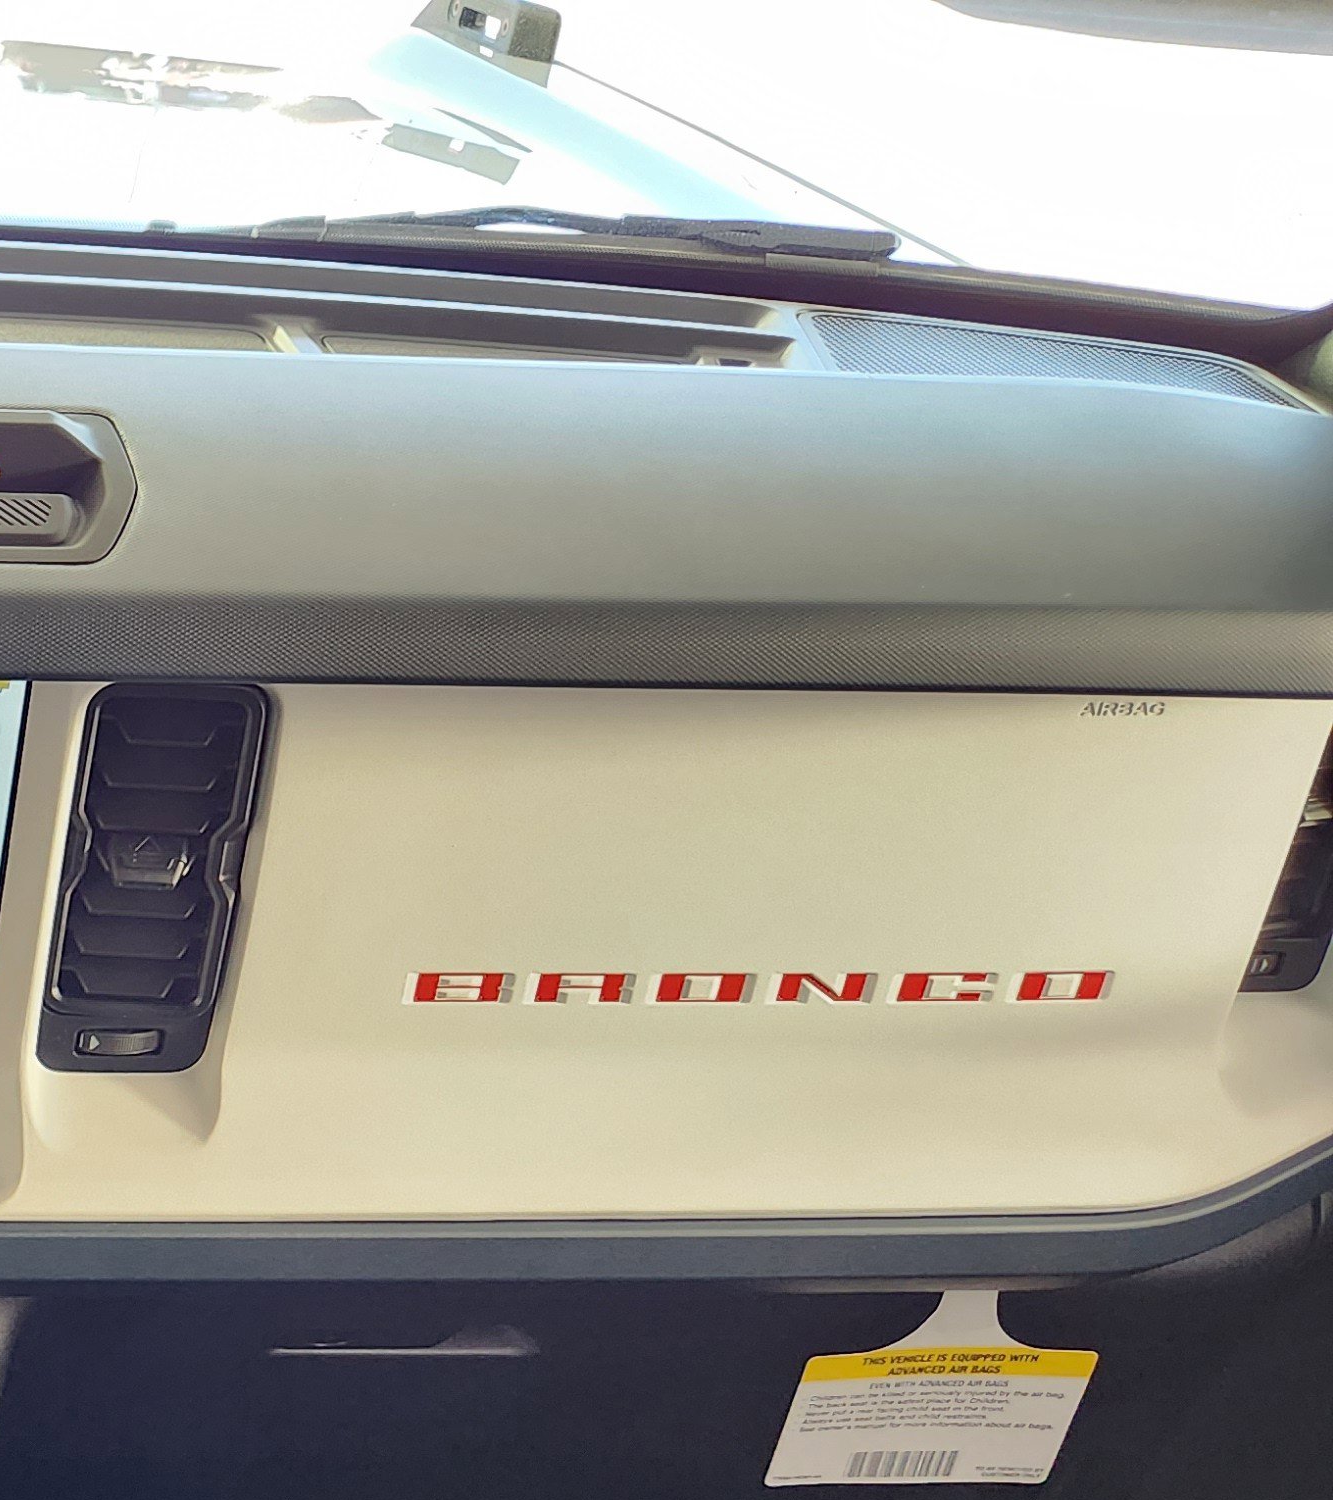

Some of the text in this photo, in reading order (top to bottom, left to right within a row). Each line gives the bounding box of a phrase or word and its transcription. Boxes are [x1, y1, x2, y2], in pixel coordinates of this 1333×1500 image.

[1079, 701, 1166, 717] AIRBAG
[404, 970, 1116, 1006] BRONCO
[862, 1353, 1040, 1366] THIS VEHICLE IS EQUIPPED WITH
[888, 1365, 1001, 1376] ADVANCED AIR BAGS
